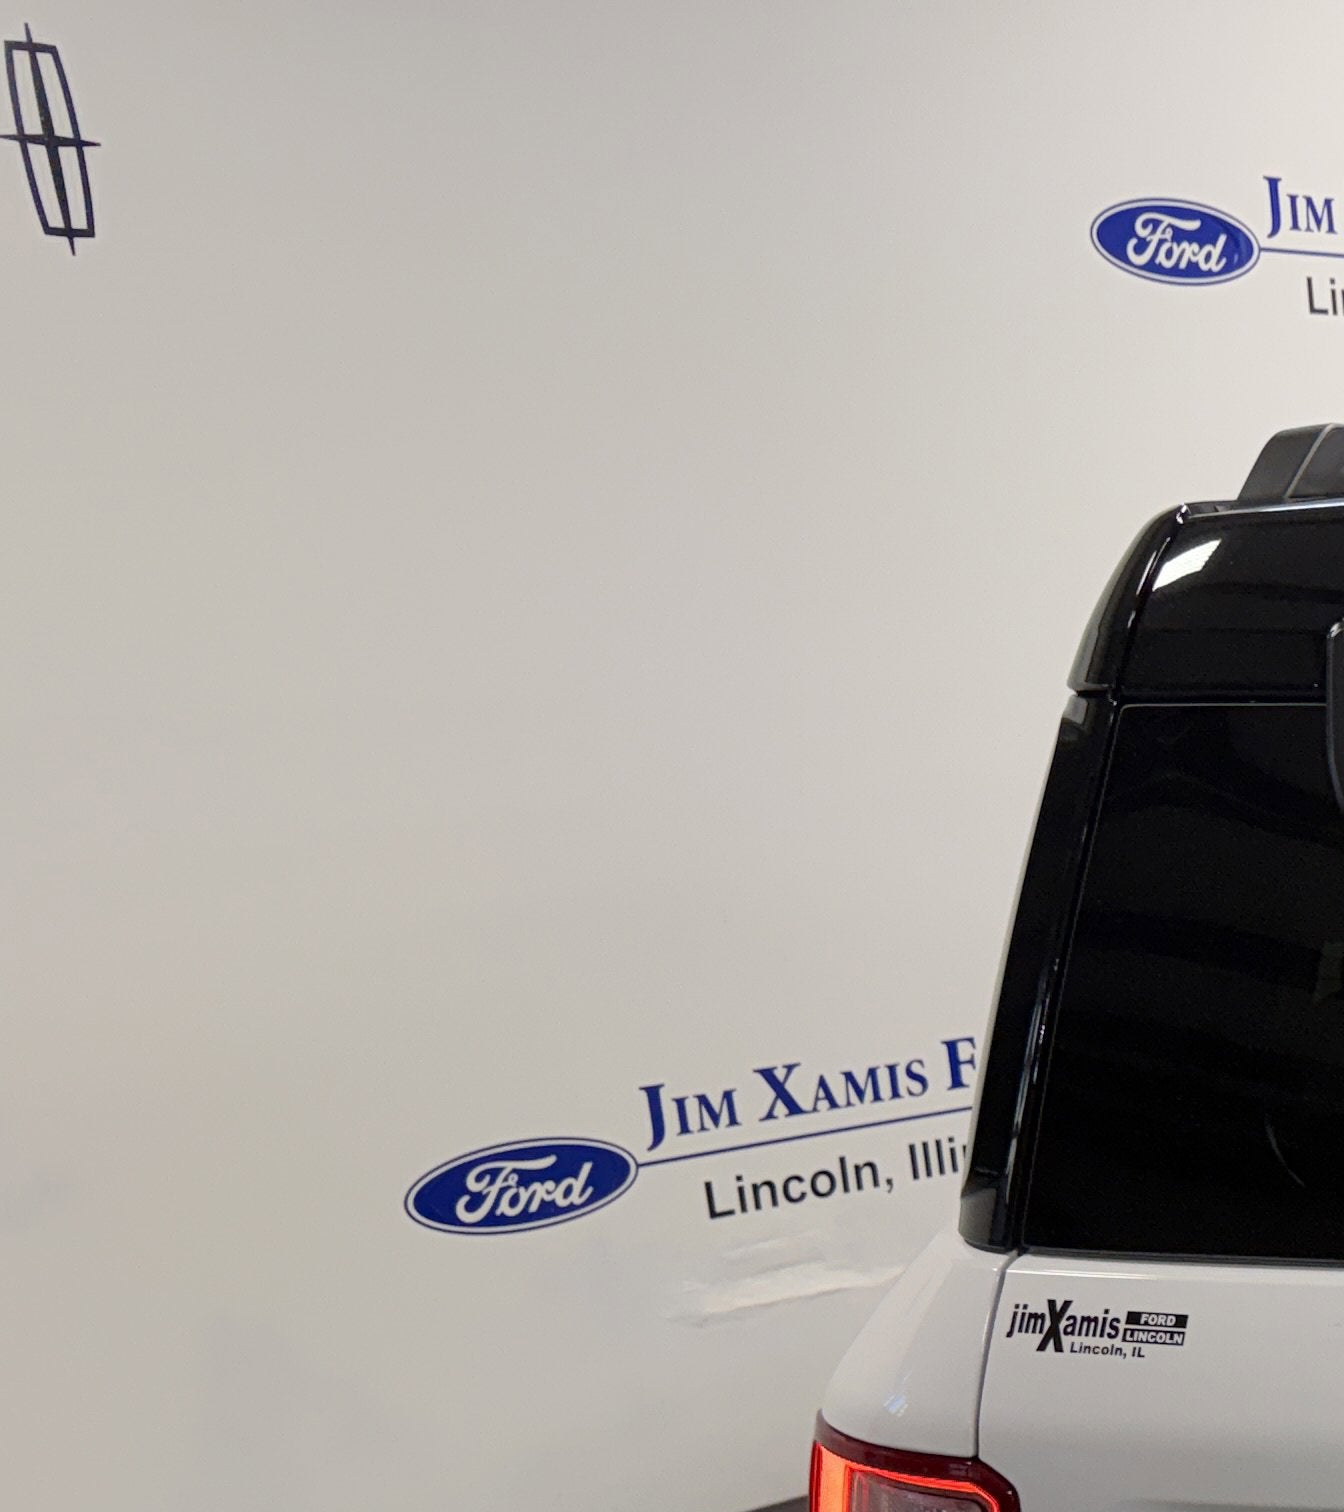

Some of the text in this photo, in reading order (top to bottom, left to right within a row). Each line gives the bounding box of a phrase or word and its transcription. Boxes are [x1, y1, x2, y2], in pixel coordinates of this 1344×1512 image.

[1263, 175, 1336, 239] JIM
[1126, 211, 1227, 274] Ford
[639, 1083, 741, 1151] JIM
[753, 1059, 929, 1123] XAMIS
[456, 1154, 593, 1224] Ford
[704, 1135, 967, 1220] Lincoln, Illi
[1070, 1341, 1146, 1359] Lincoln, IL
[1125, 1331, 1184, 1345] LINCOLN
[1139, 1313, 1177, 1327] FORD
